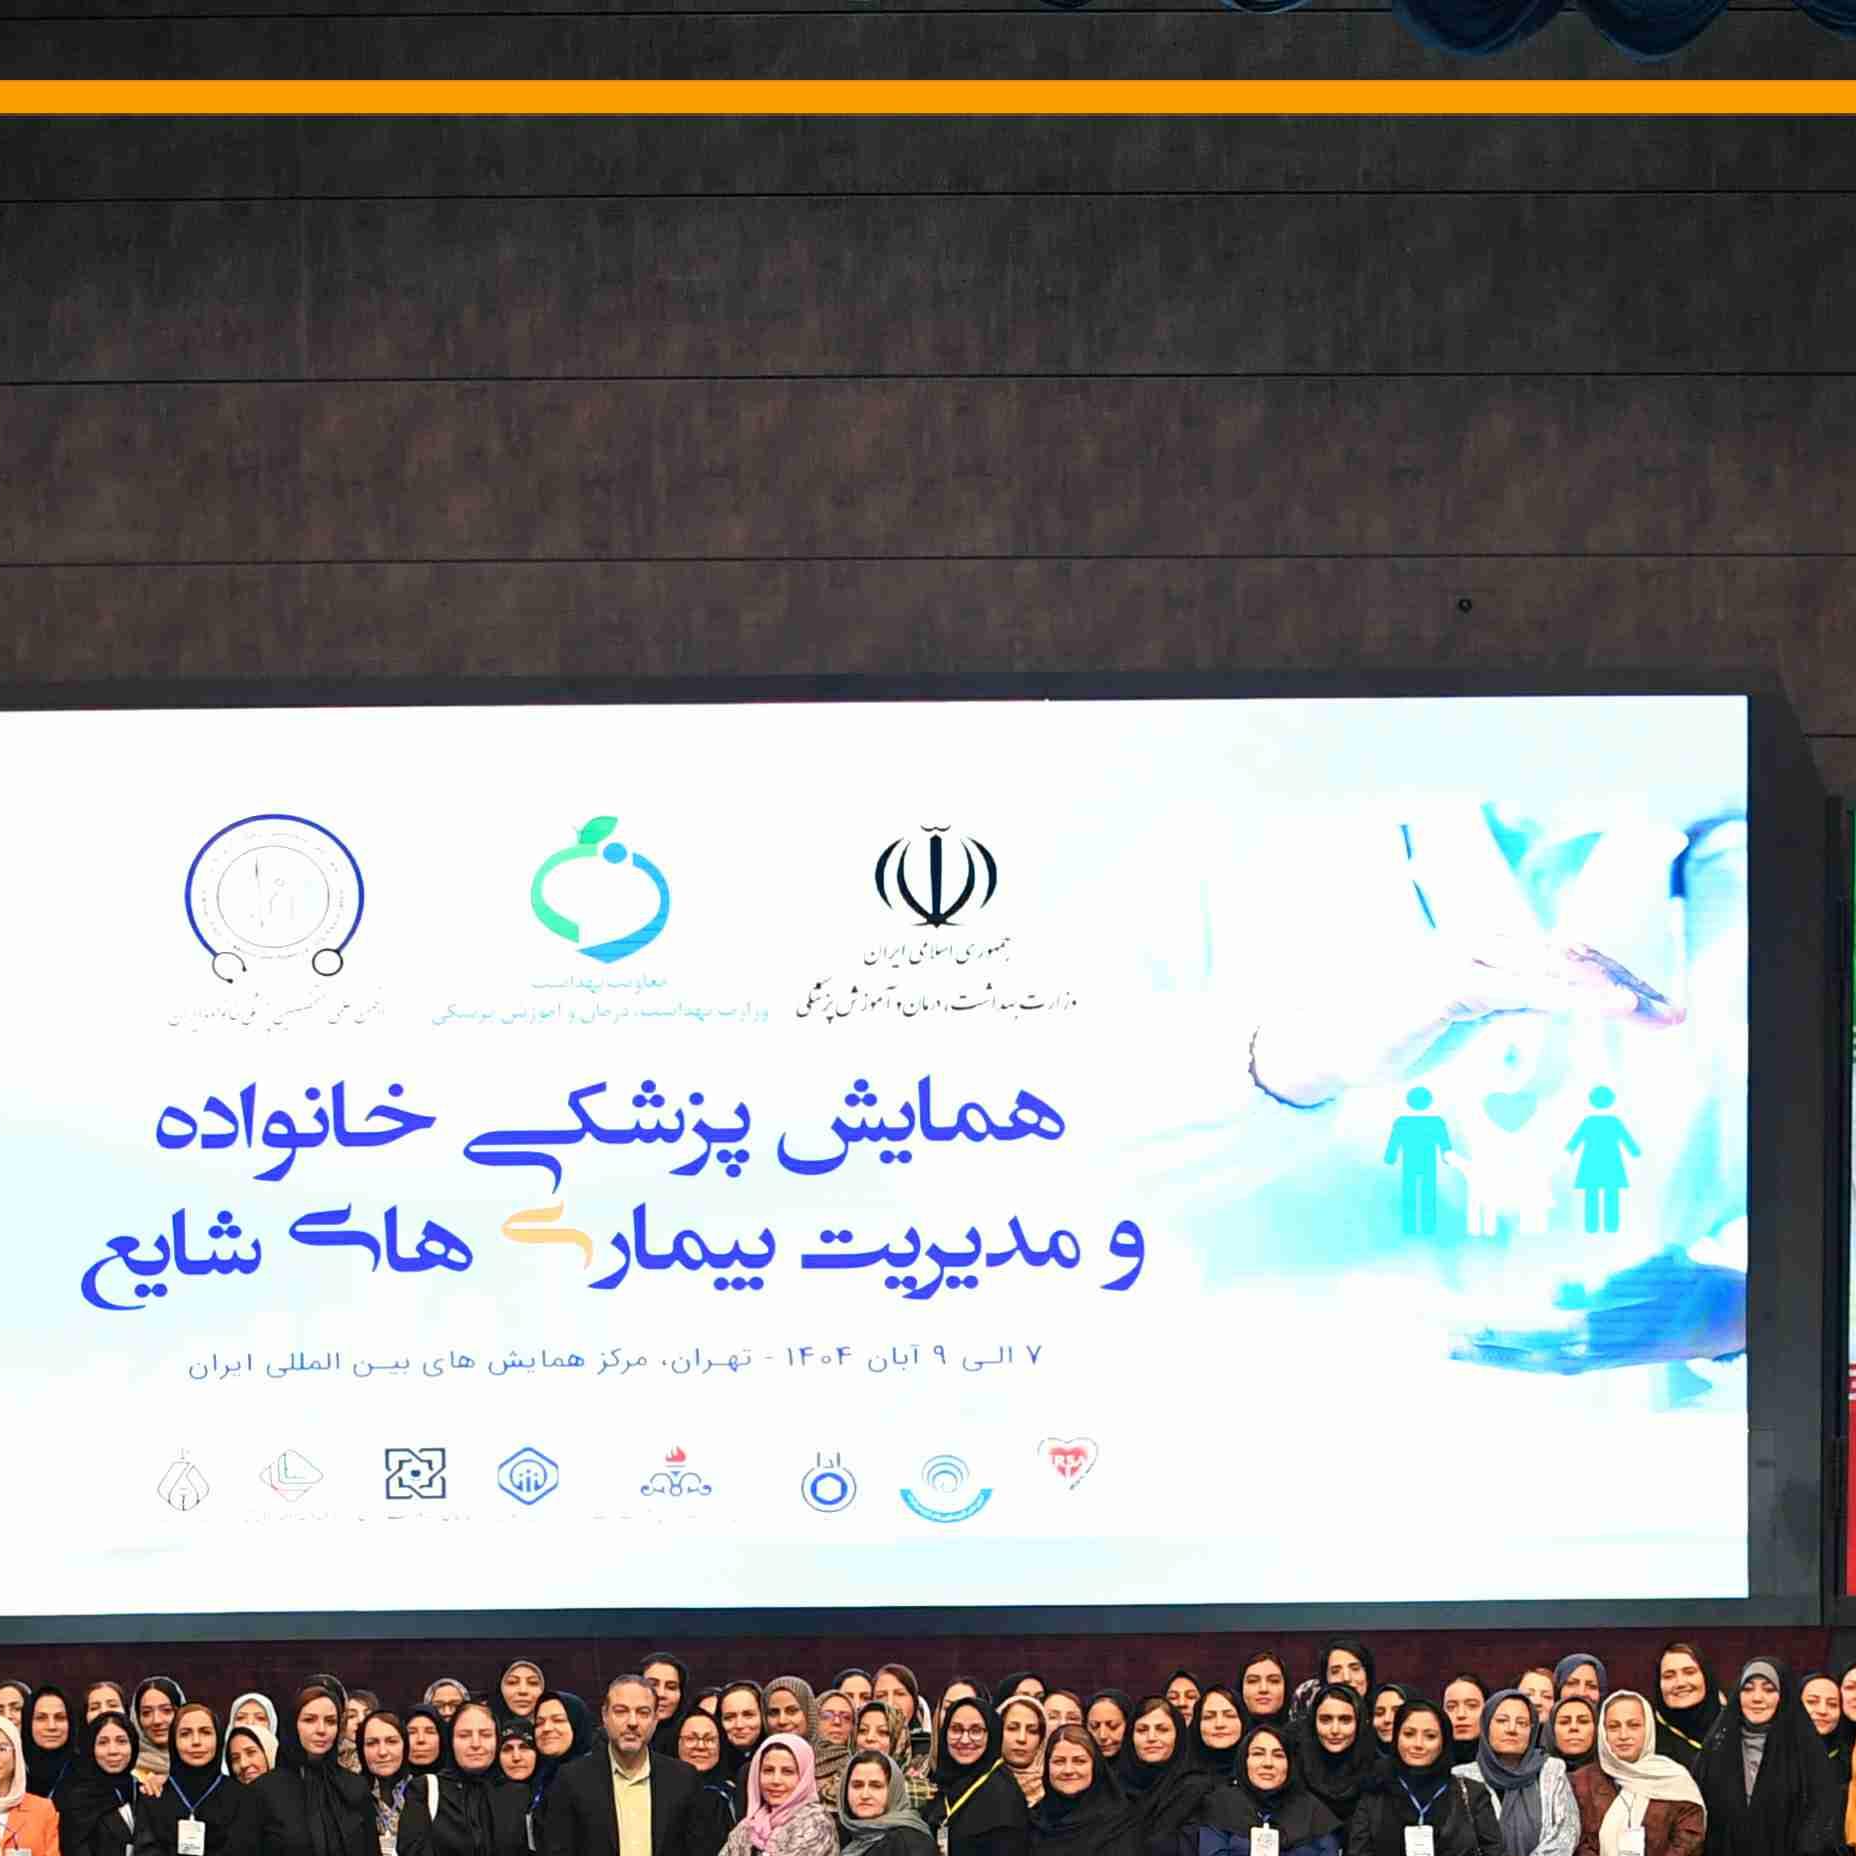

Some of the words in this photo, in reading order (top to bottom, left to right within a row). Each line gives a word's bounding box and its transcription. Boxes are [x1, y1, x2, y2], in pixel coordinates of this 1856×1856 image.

[155, 1080, 437, 1182] خانواده
[462, 1079, 751, 1194] پزشکی
[776, 1074, 1066, 1176] همایش
[287, 1203, 474, 1273] های
[501, 1202, 776, 1292] بیماری
[80, 1207, 262, 1312] شایع
[800, 1215, 1081, 1301] مدیریت
[1099, 1219, 1145, 1292] و
[188, 1352, 253, 1381] ایران
[265, 1351, 340, 1379] المللی
[352, 1358, 411, 1378] بین
[422, 1350, 476, 1378] های
[487, 1349, 585, 1377] همایش
[597, 1347, 648, 1376] مرکز
[787, 1345, 852, 1367] ۱۴۰۴
[867, 1343, 920, 1374] آبان
[932, 1344, 947, 1366] ۹
[961, 1345, 1013, 1373] الی
[1025, 1344, 1043, 1365] ۷
